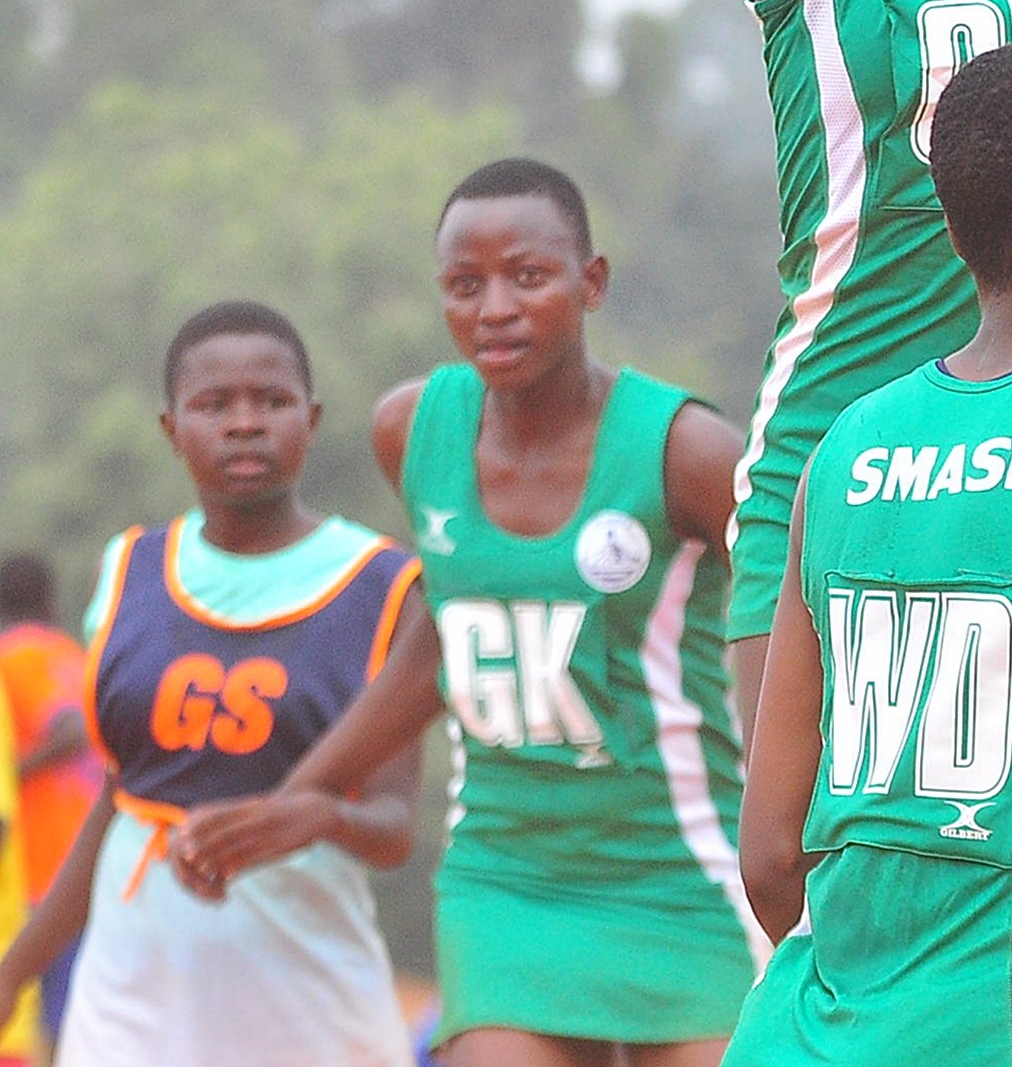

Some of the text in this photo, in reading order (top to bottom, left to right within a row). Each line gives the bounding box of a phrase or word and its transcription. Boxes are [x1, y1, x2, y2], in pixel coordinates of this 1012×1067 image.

[151, 654, 288, 755] GS
[439, 598, 604, 747] GK
[940, 827, 993, 842] GILBERT
